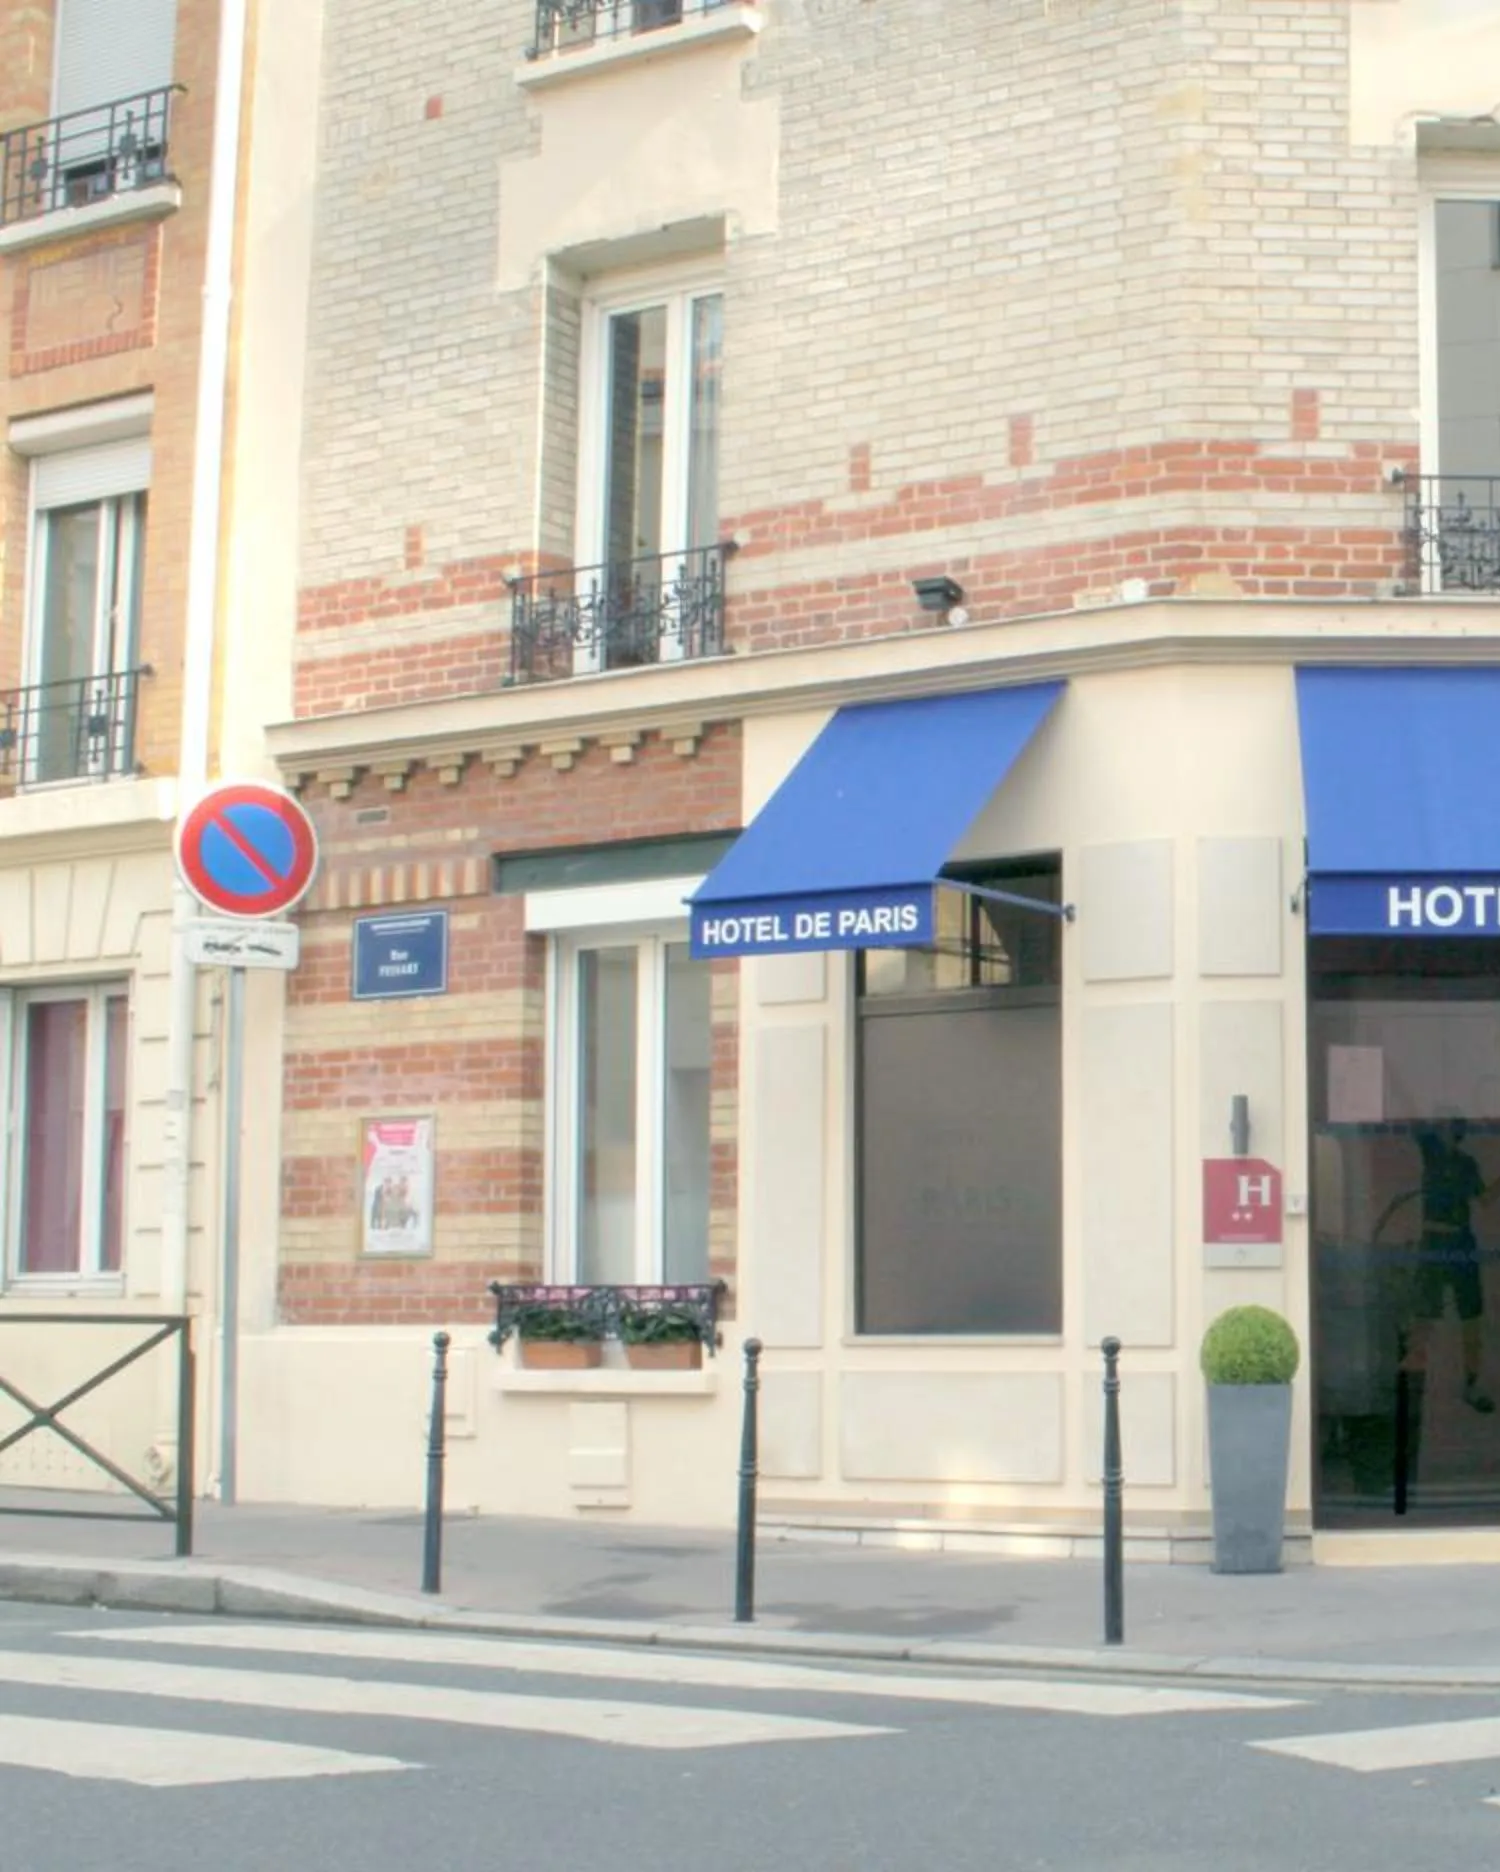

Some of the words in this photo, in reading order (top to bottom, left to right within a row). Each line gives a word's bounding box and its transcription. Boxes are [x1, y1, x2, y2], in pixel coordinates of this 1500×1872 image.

[702, 915, 788, 945] HOTEL
[794, 911, 832, 940] DE
[837, 903, 919, 937] PARIS
[1237, 1174, 1271, 1206] H
